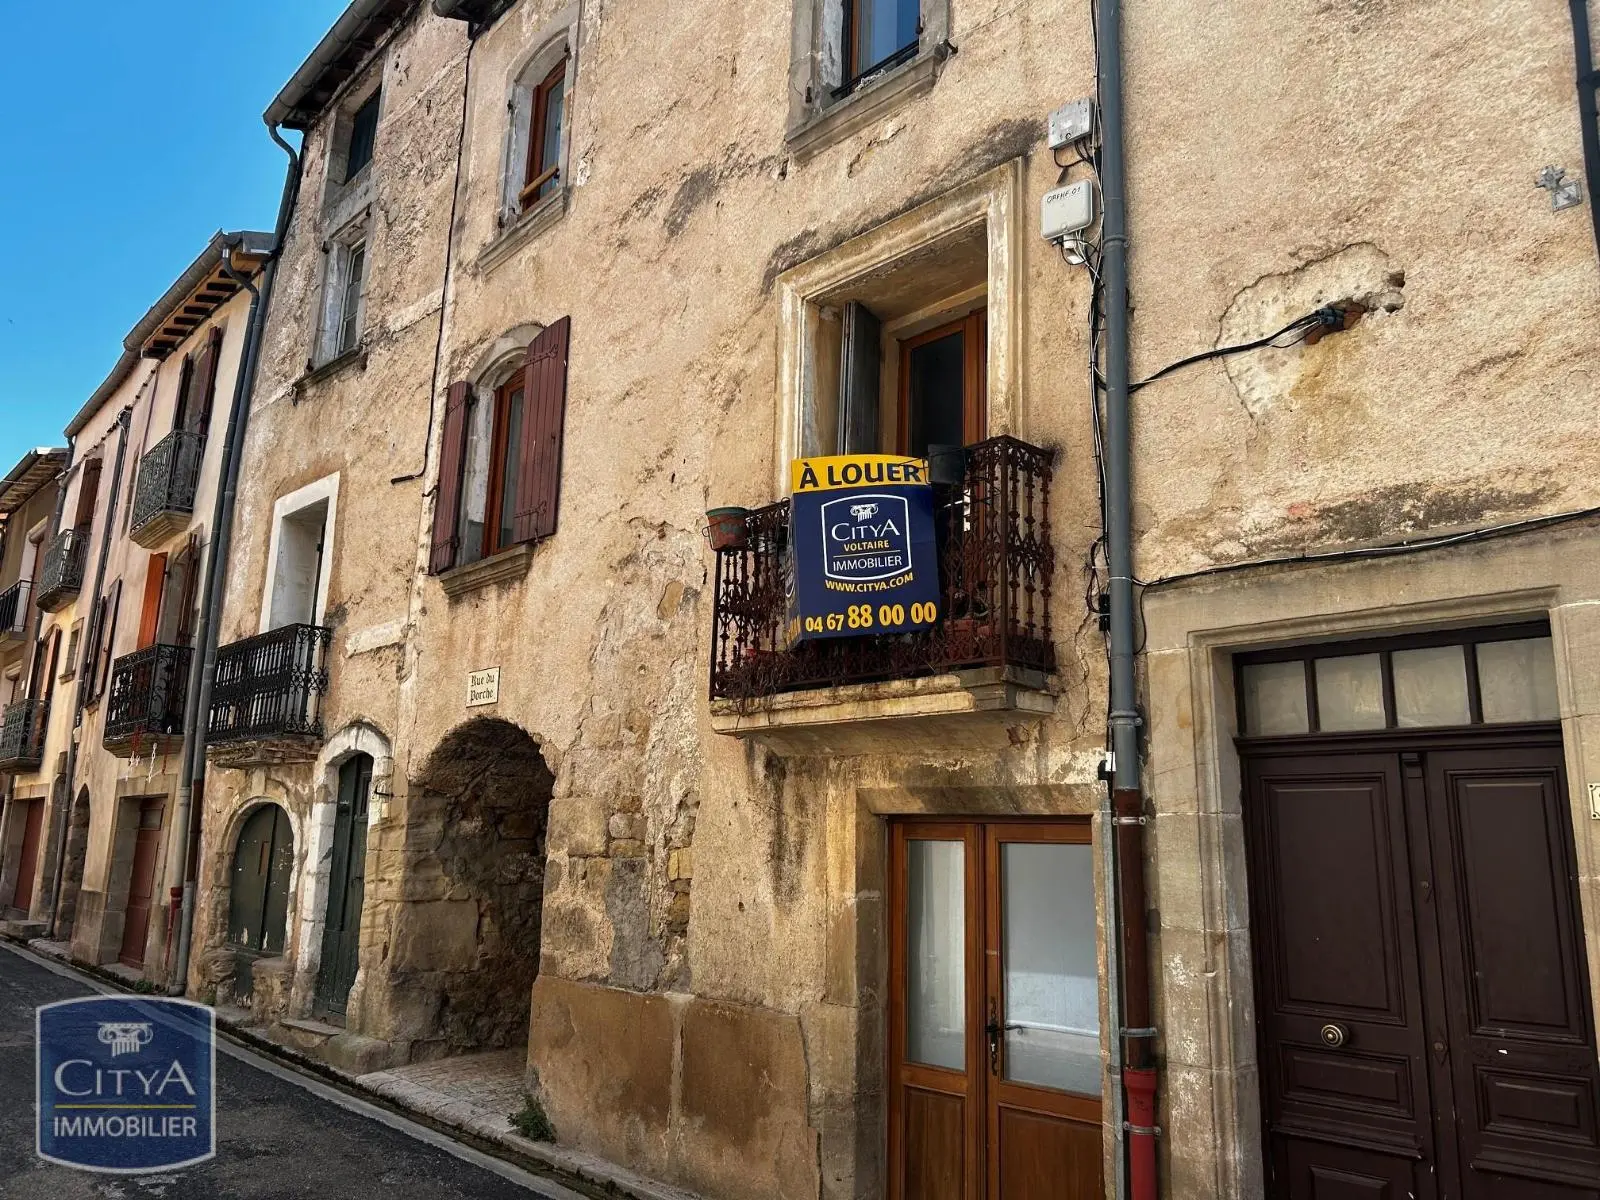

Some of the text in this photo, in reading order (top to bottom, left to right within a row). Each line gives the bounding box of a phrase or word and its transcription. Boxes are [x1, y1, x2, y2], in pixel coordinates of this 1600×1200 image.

[800, 462, 921, 488] À LOUER
[844, 540, 889, 551] VOLTAIRE
[833, 556, 902, 571] IMMOBILIER
[825, 573, 914, 592] WWW.CITYA.COM
[805, 617, 823, 632] 04
[826, 614, 844, 630] 67
[848, 604, 873, 628] 88
[879, 604, 905, 625] 00
[911, 602, 937, 623] 00
[471, 673, 494, 686] Rue du
